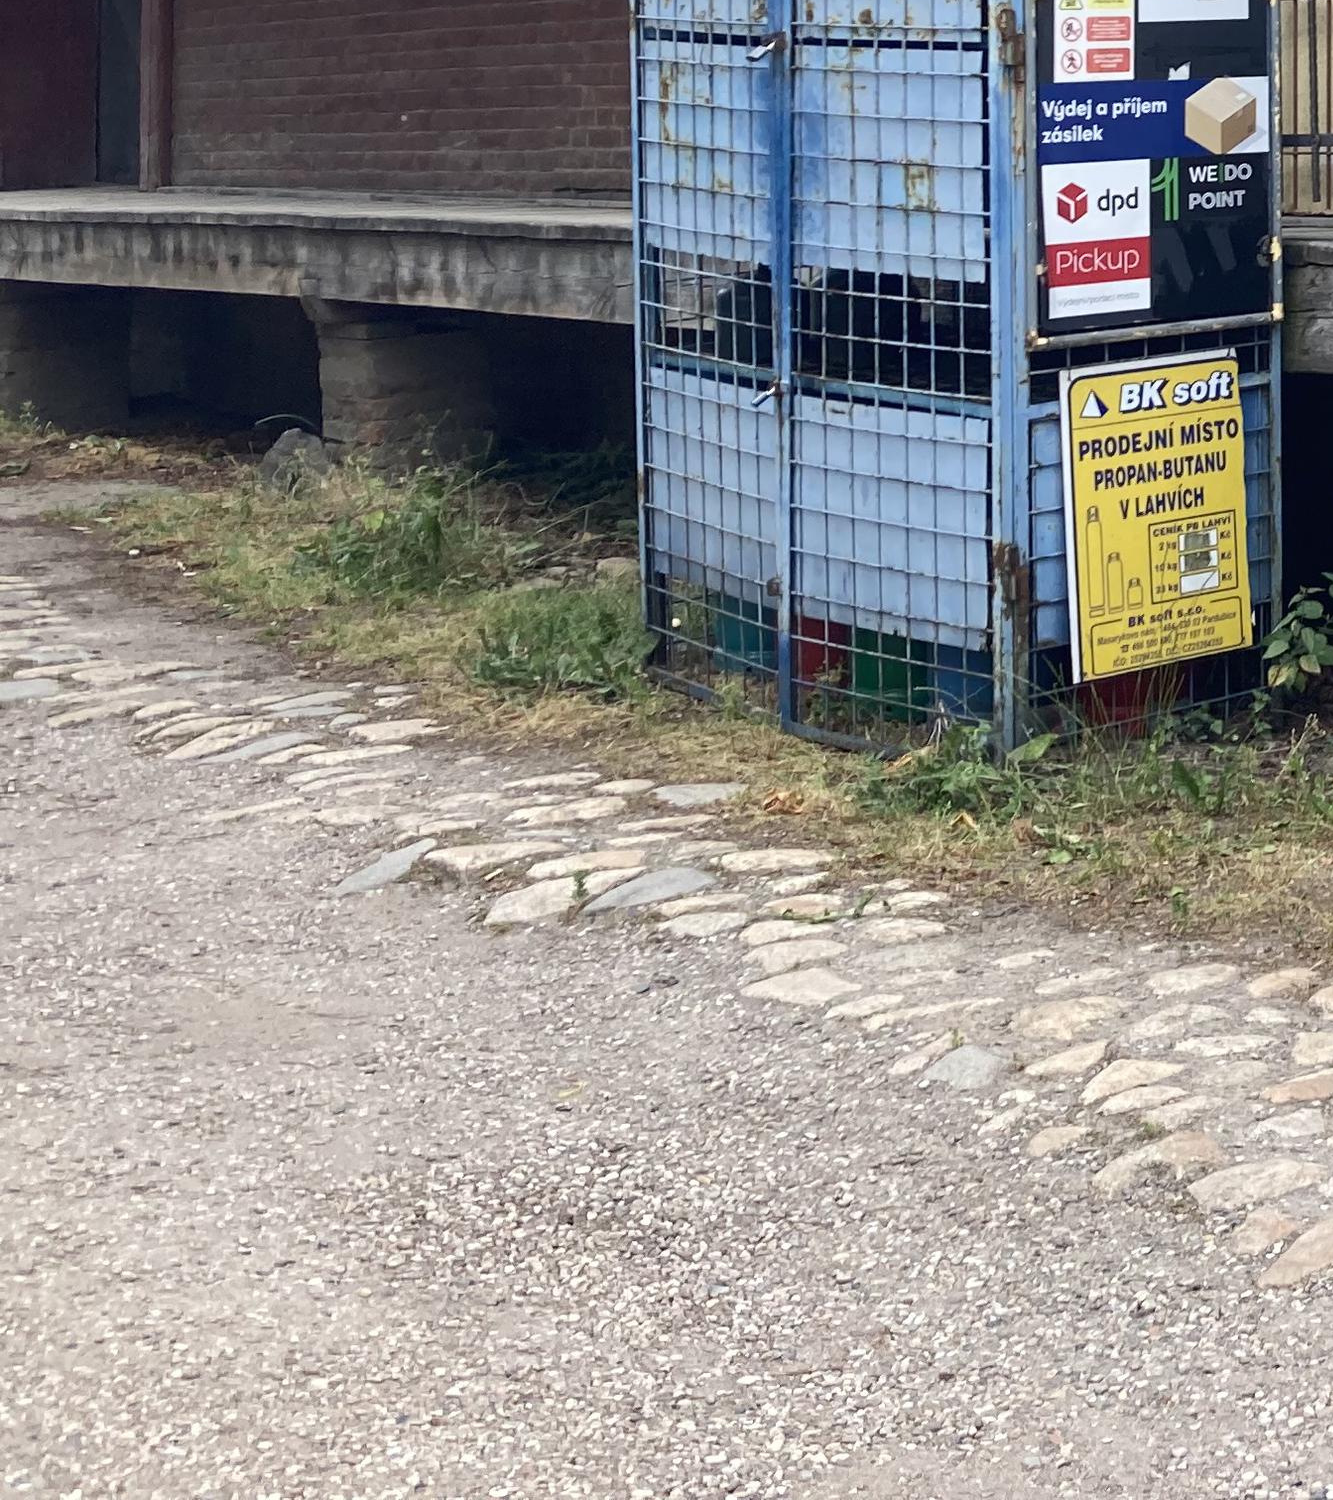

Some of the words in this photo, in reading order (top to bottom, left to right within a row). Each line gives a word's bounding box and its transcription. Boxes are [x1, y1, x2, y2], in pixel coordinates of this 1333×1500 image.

[1041, 98, 1093, 122] Výdej
[1096, 101, 1107, 114] a
[1112, 97, 1168, 119] příjem
[1041, 125, 1104, 144] zásilek
[1224, 163, 1252, 181] DO
[1097, 186, 1139, 217] dpd
[1188, 189, 1246, 210] POINT
[1055, 247, 1140, 275] Pickup
[1118, 378, 1168, 415] BK
[1173, 370, 1234, 408] soft
[1078, 422, 1174, 461] PRODEJNÍ
[1180, 413, 1239, 443] MÍSTO
[1094, 451, 1227, 492] PROPAN-BUTANU
[1119, 498, 1131, 520] V
[1135, 484, 1205, 517] LAHVÍCH
